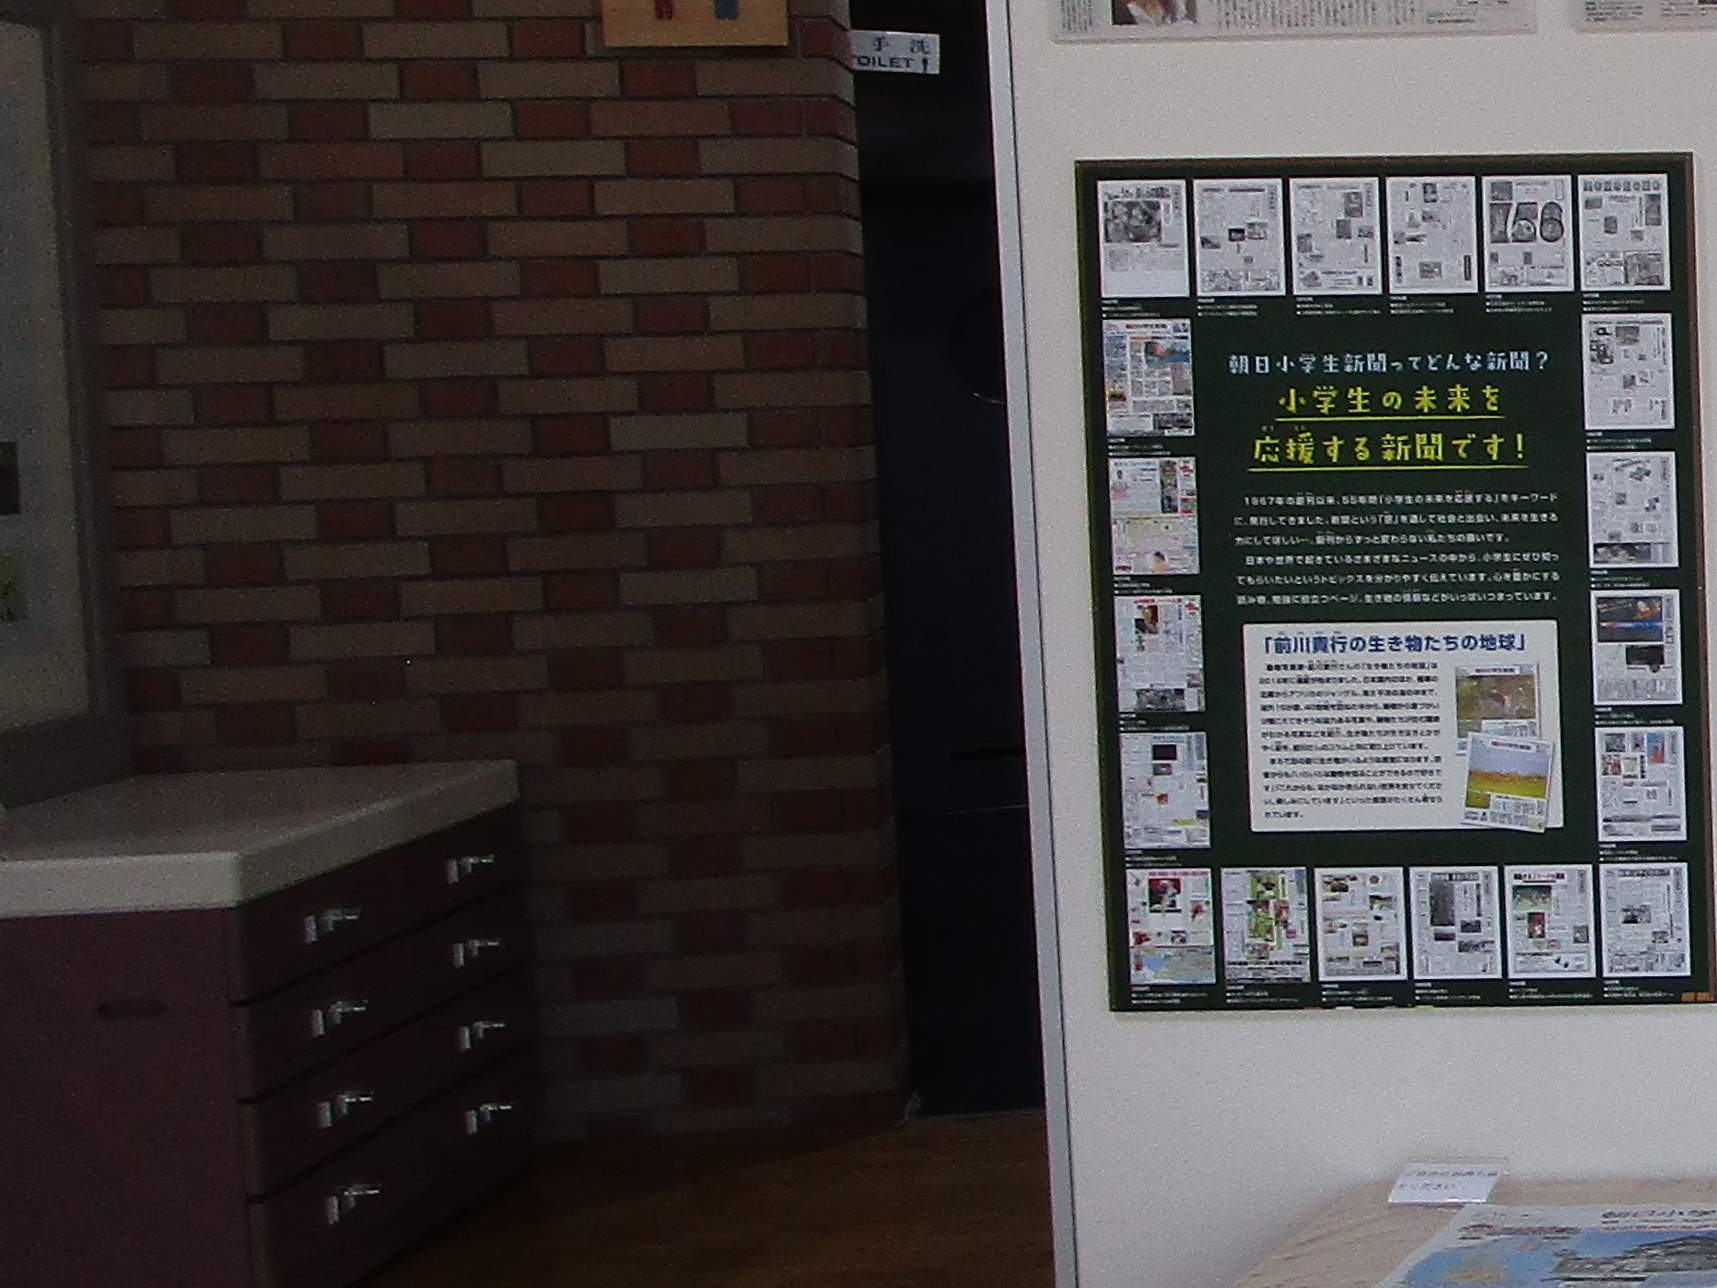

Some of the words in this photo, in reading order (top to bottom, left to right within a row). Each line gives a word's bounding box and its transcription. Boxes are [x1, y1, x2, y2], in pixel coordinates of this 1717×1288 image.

[852, 55, 915, 68] OILET
[1228, 350, 1549, 375] 朝日小学生新聞ってどんな新聞？
[1277, 383, 1501, 415] 小学生の未来を
[1253, 431, 1525, 464] 応援する新聞です！
[1264, 633, 1526, 654] 「前川貴行の生き物たちの地球」
